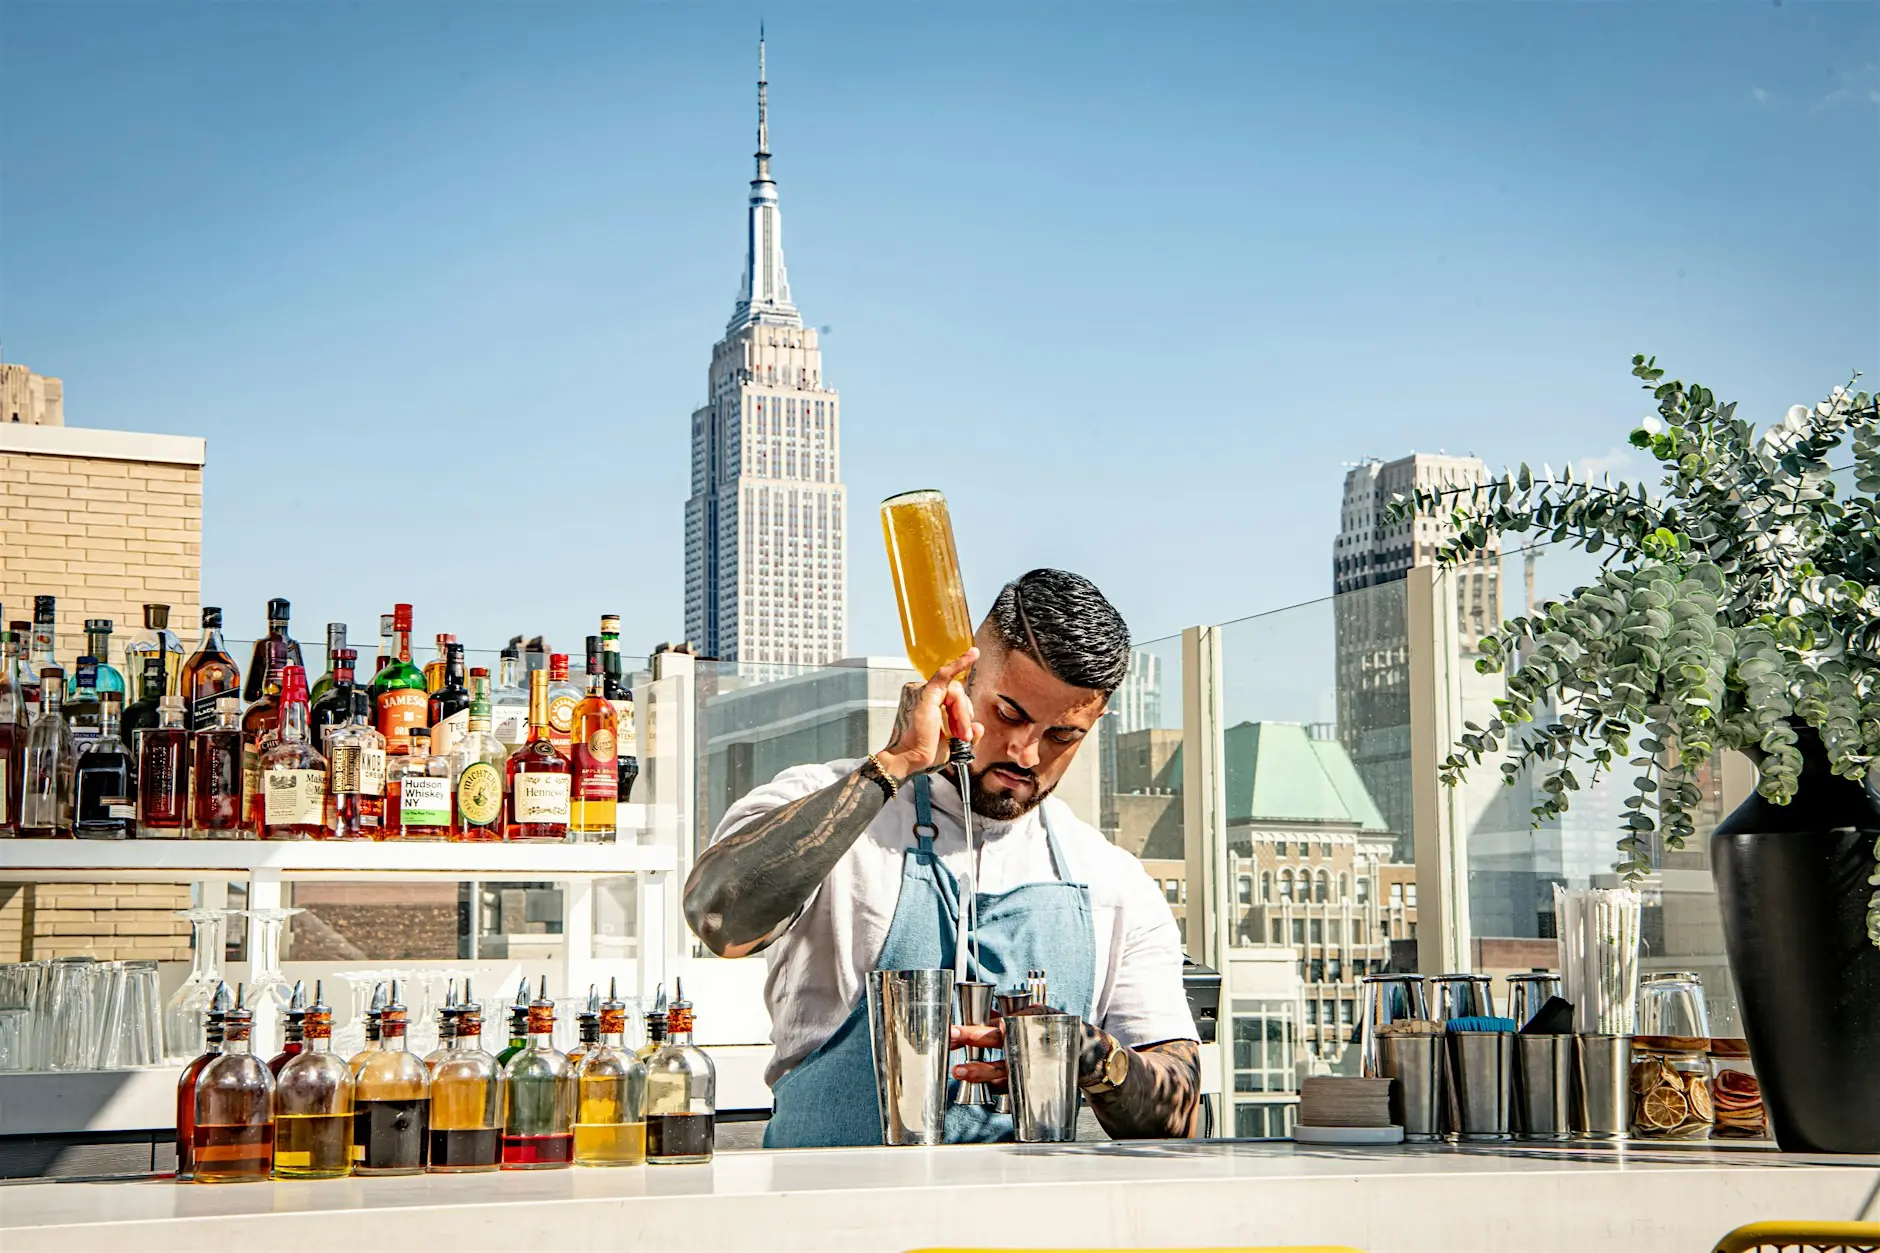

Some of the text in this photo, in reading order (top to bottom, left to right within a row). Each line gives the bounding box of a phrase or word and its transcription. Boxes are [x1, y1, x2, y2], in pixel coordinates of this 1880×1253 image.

[194, 706, 216, 718] BLACK
[361, 752, 382, 772] KNOB
[335, 749, 344, 791] KNOB CREEK
[365, 771, 384, 779] CREEK
[405, 779, 442, 788] Hudson
[405, 789, 444, 800] Whiskey
[405, 799, 419, 807] NY
